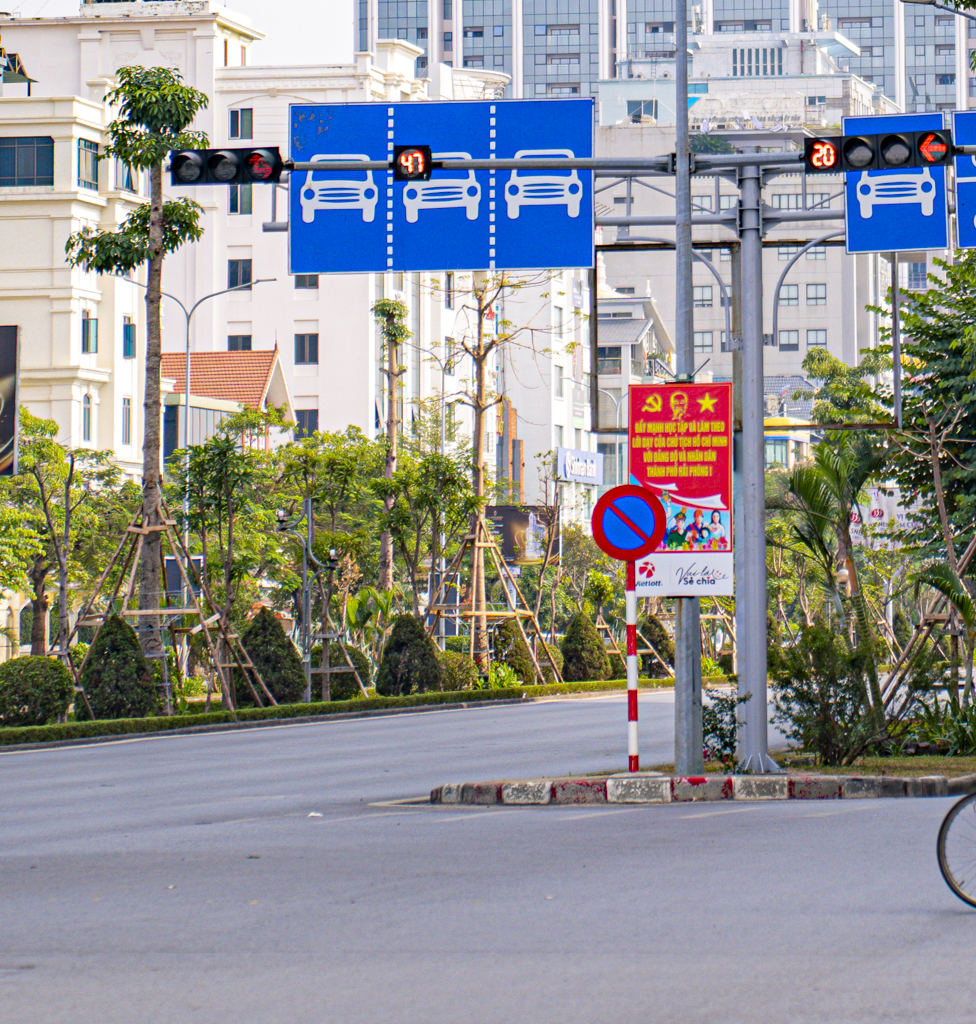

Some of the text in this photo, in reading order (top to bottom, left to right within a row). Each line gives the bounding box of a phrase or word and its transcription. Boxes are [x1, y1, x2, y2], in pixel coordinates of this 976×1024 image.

[811, 142, 836, 167] 20
[400, 151, 424, 173] 47
[711, 421, 725, 432] THEO
[712, 436, 727, 447] MINH
[696, 576, 716, 586] chia
